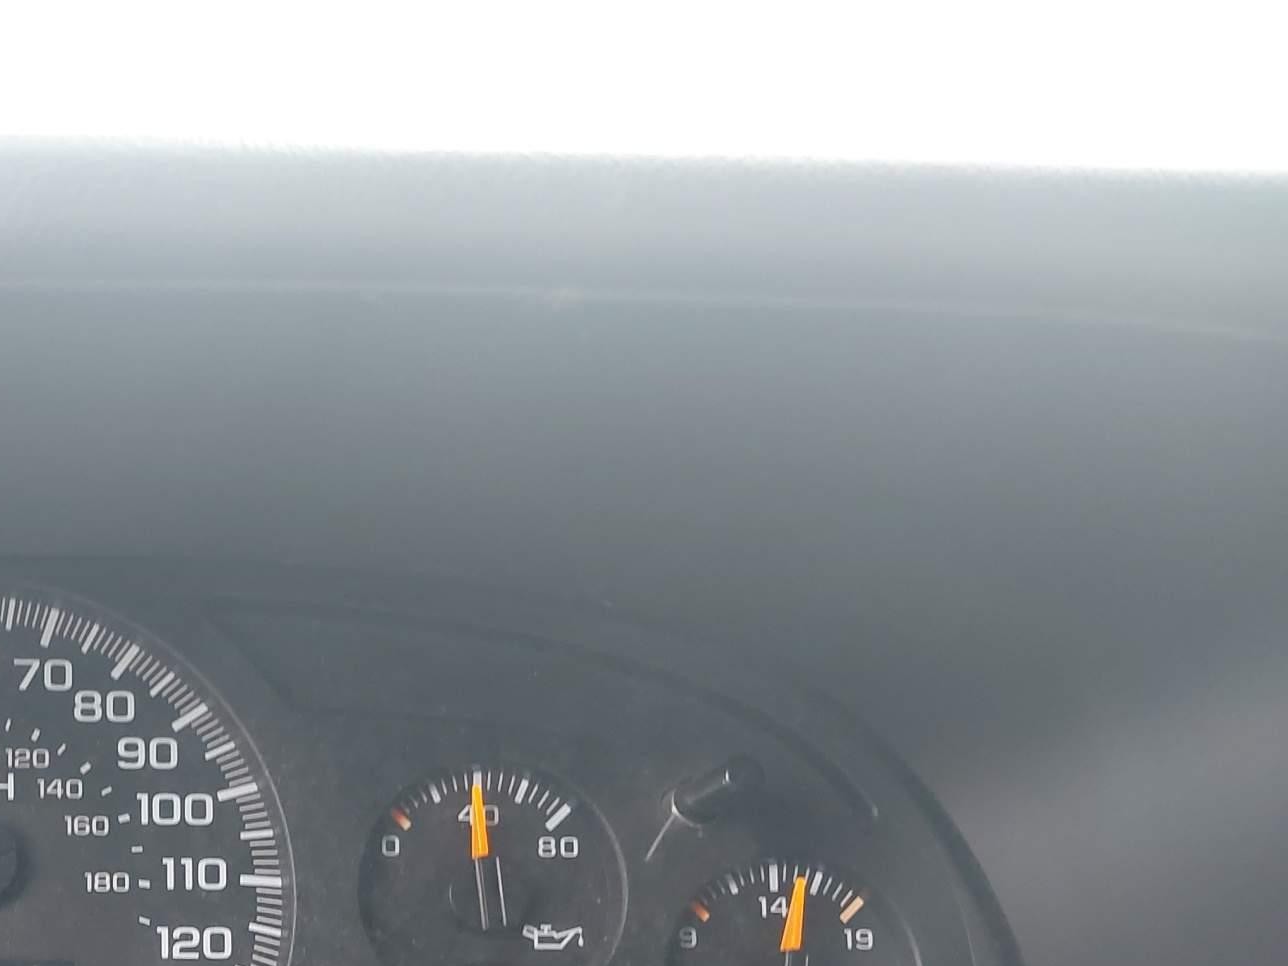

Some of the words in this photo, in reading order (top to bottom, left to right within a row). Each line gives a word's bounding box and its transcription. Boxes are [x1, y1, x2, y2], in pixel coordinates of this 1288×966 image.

[14, 659, 72, 690] 70
[74, 691, 134, 721] 80
[6, 749, 49, 768] 120
[118, 738, 177, 769] 90
[38, 779, 82, 798] 140
[137, 793, 213, 825] 100
[65, 816, 108, 835] 160
[382, 836, 399, 856] 0
[539, 837, 578, 857] 80
[85, 872, 129, 892] 180
[163, 858, 226, 890] 110
[758, 896, 788, 918] 14
[157, 927, 231, 959] 120
[679, 929, 697, 948] 9
[845, 929, 873, 949] 19
